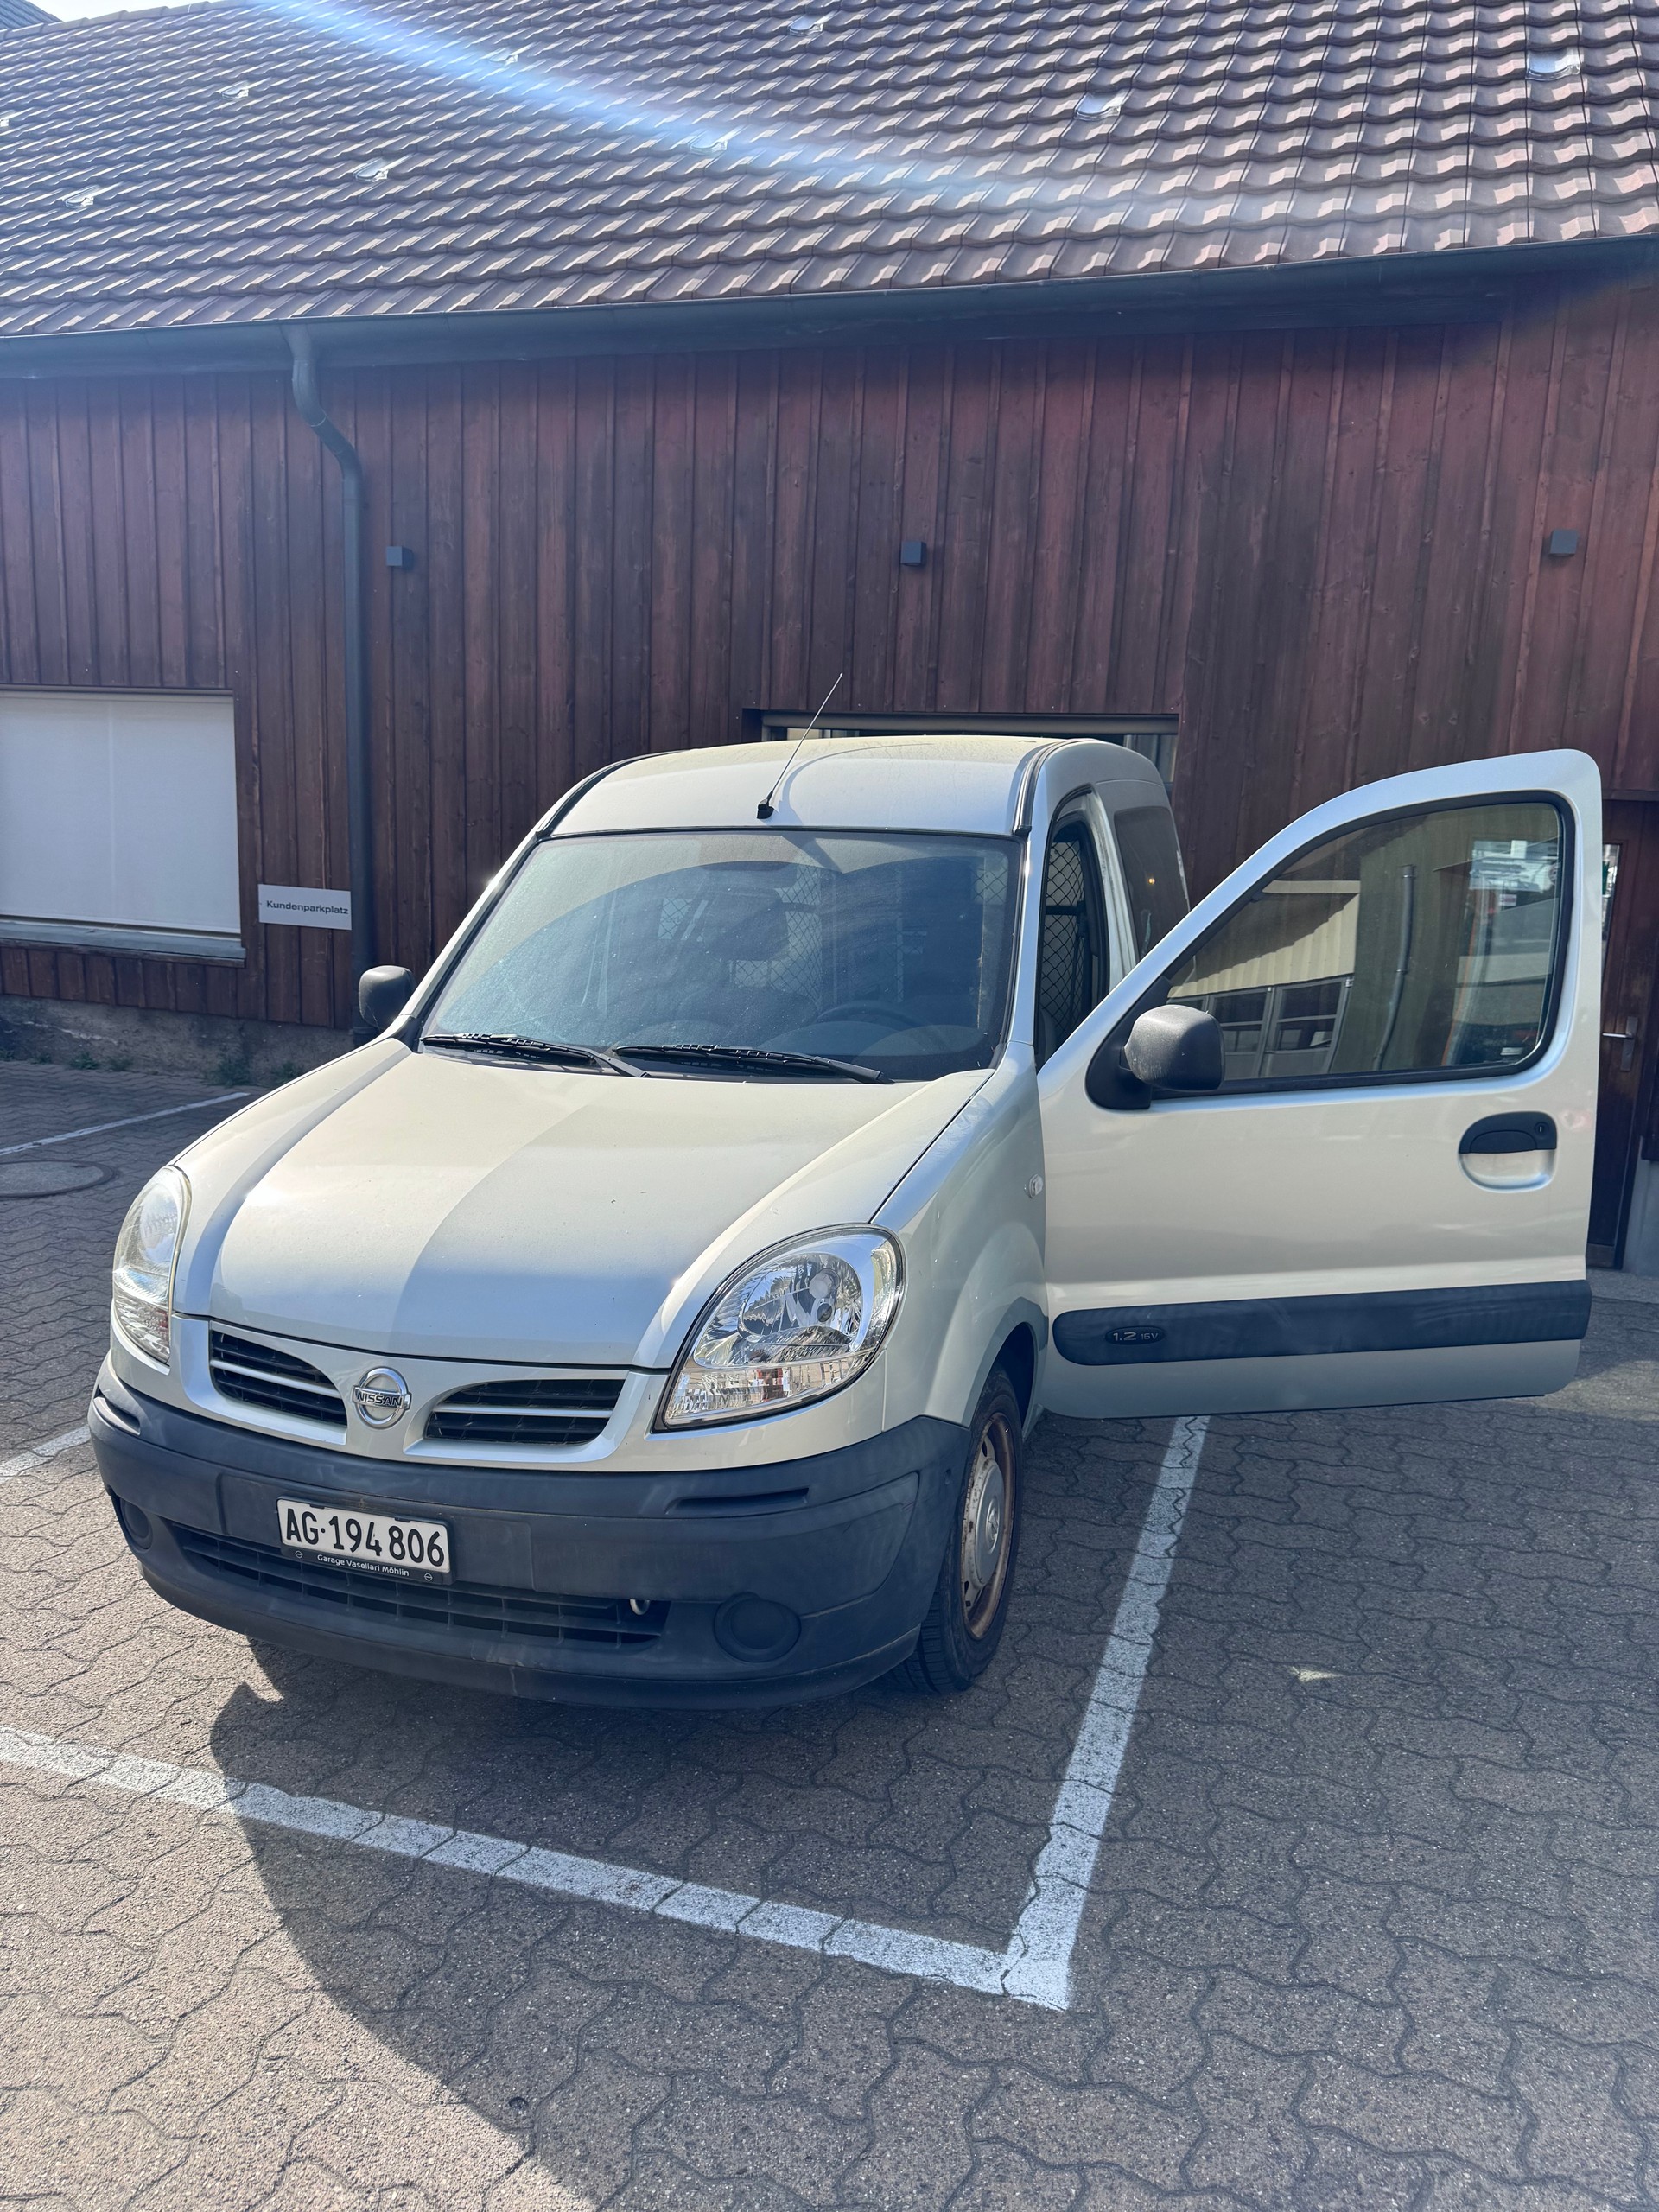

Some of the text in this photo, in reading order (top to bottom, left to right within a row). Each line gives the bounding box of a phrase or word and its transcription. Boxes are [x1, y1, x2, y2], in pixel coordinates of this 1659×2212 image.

[266, 900, 349, 915] Kundenparkplatz
[1113, 1332, 1137, 1341] 1.2
[356, 1390, 403, 1407] NISSAN
[317, 1554, 346, 1566] Garage
[382, 1566, 410, 1576] Möhlin
